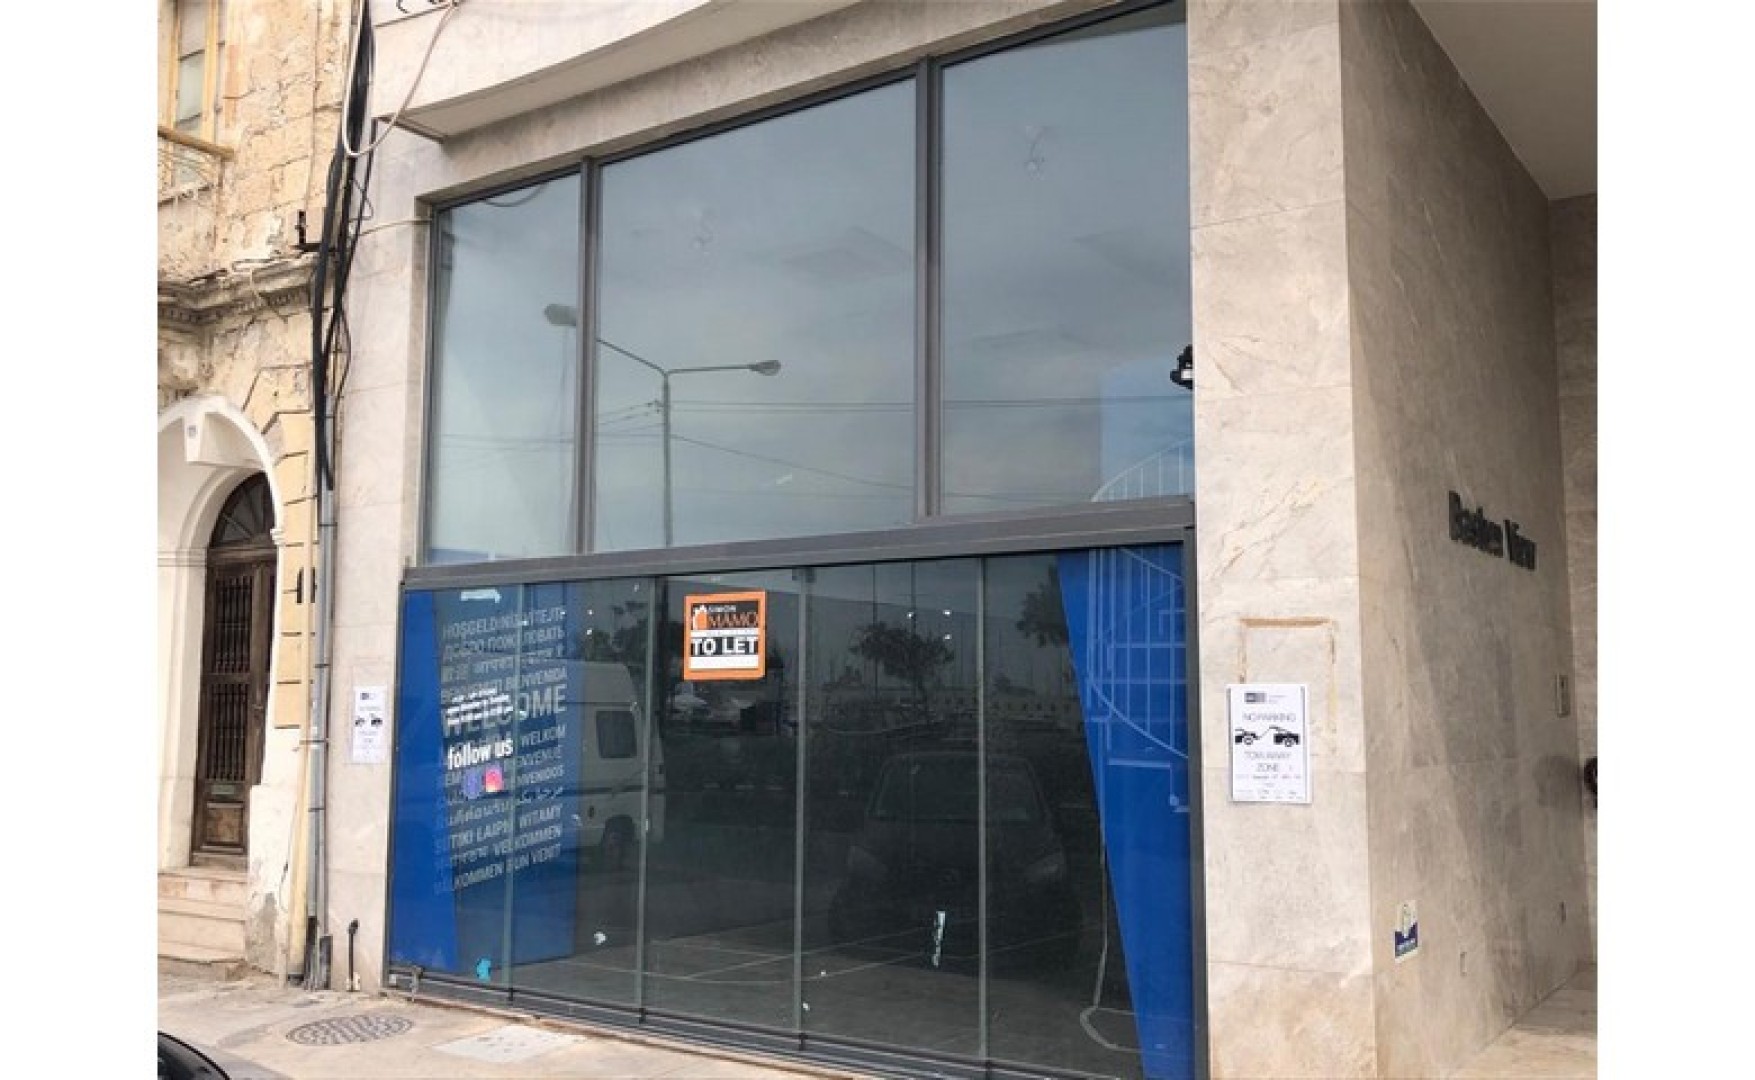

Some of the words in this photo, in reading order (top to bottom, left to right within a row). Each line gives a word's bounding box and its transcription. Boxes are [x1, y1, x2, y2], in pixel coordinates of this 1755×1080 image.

[708, 612, 757, 628] MAMO
[691, 637, 716, 656] TO
[722, 636, 758, 654] LET
[447, 741, 491, 770] follow
[494, 737, 514, 757] us
[1256, 762, 1279, 773] ZONE
